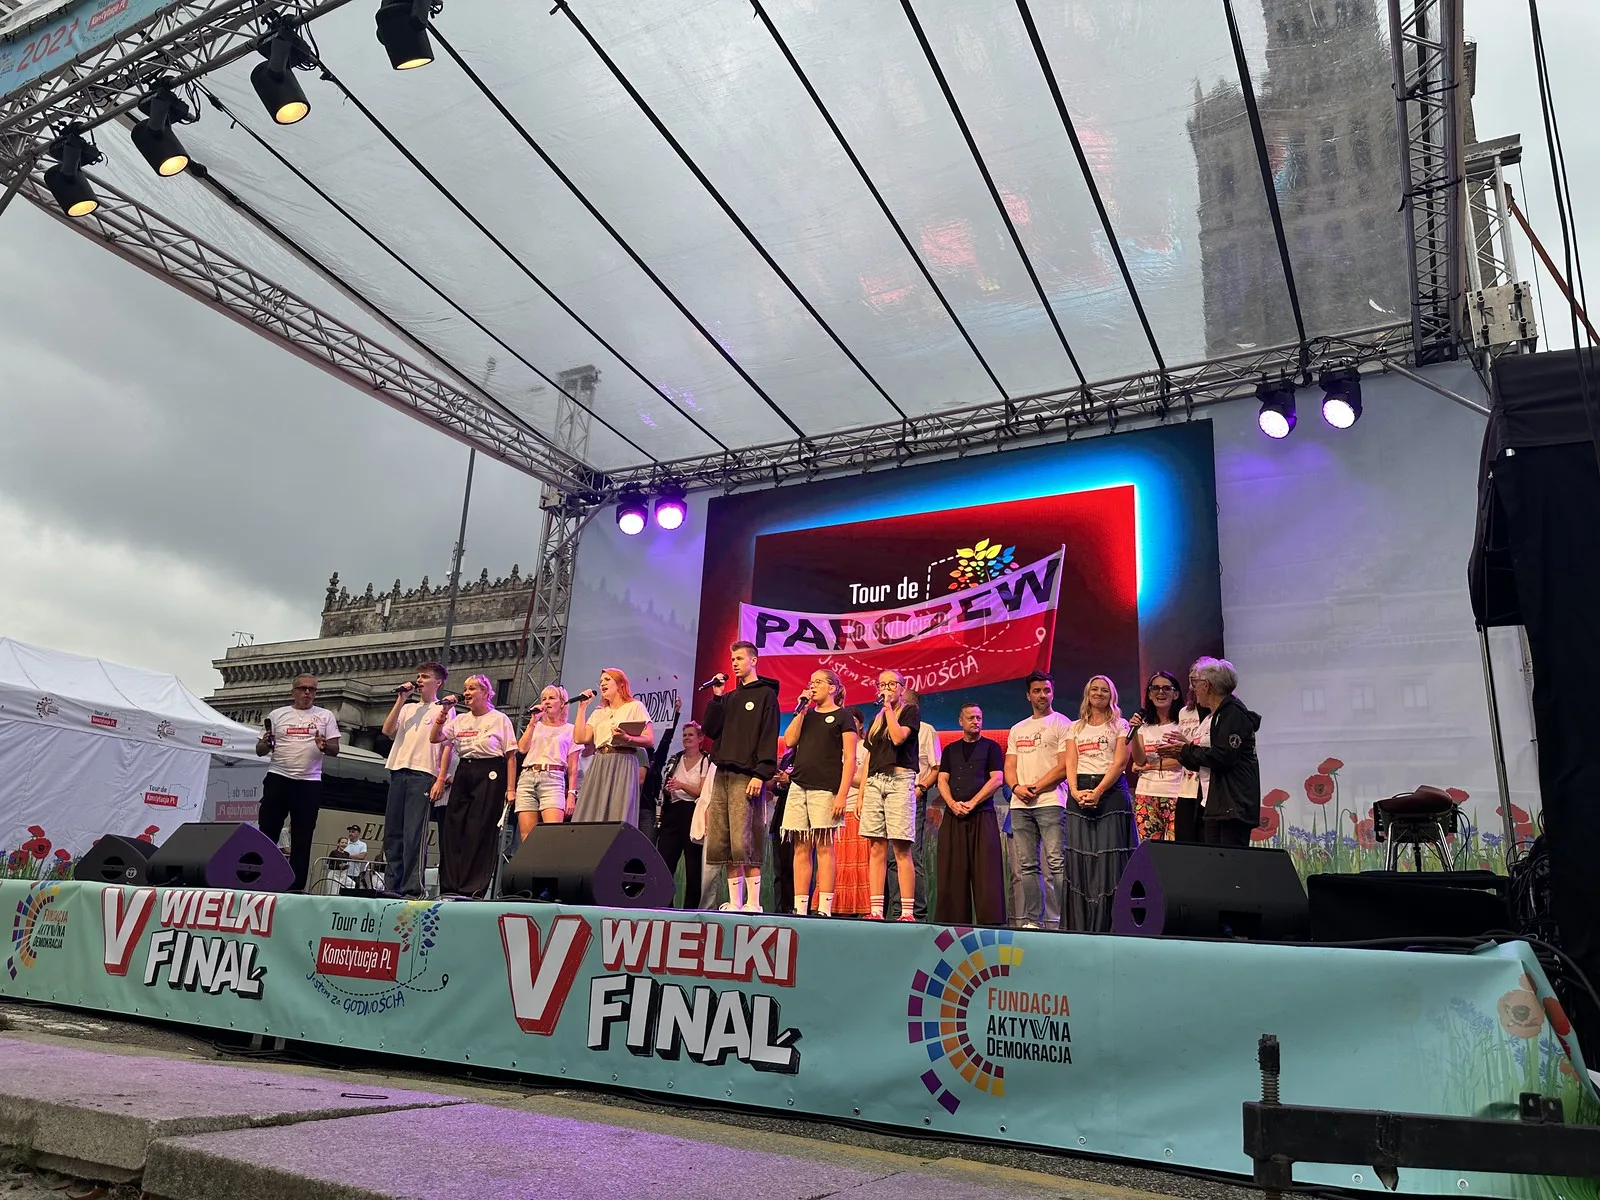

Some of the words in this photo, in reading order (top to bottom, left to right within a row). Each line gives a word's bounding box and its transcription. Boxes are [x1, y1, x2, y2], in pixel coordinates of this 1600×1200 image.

[755, 558, 1060, 650] PARCZEW
[849, 583, 890, 604] Tour
[897, 576, 918, 600] de
[903, 655, 979, 692] DNOŚCIĄ
[101, 886, 157, 976] V
[160, 889, 277, 937] WIELKI
[331, 912, 357, 931] Tour
[361, 912, 375, 933] de
[143, 929, 268, 1000] FINAŁ
[322, 943, 378, 973] Konstytucja
[380, 948, 392, 970] PL
[498, 912, 594, 1036] V
[600, 917, 799, 987] WIELKI
[988, 987, 1070, 1017] FUNDACJA
[586, 973, 803, 1077] FINAŁ
[986, 1036, 1073, 1065] DEMOKRACJA
